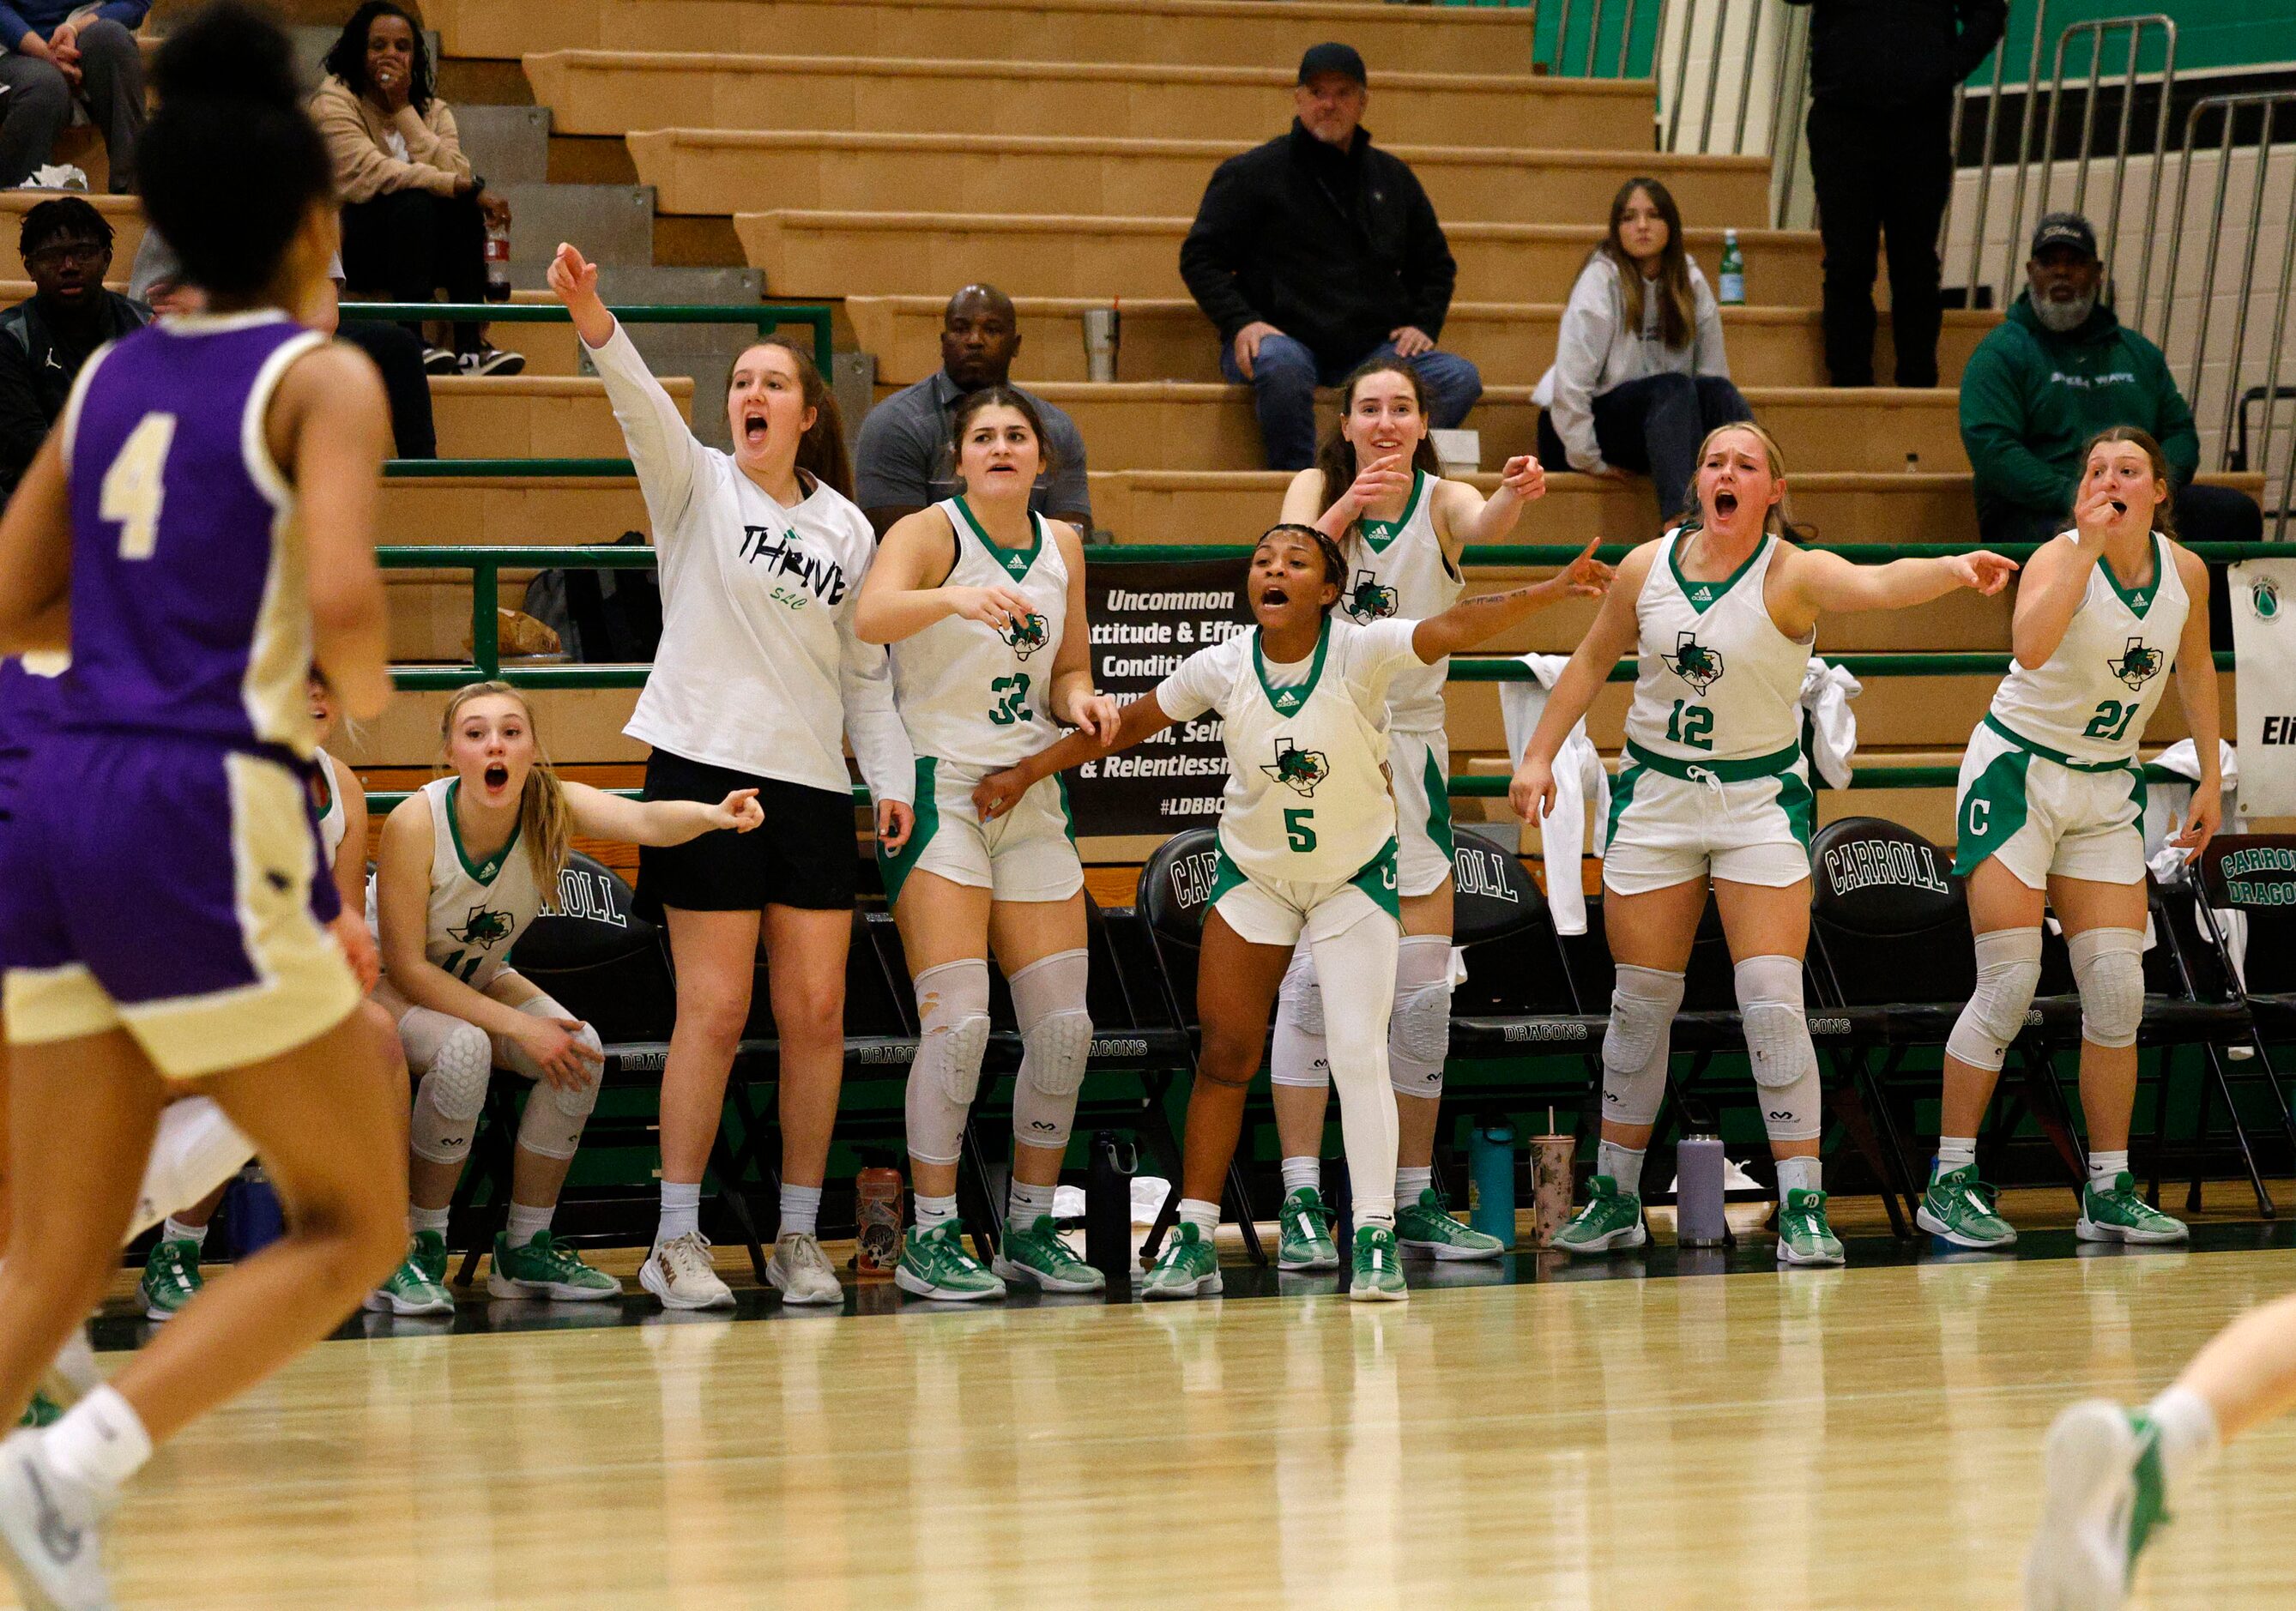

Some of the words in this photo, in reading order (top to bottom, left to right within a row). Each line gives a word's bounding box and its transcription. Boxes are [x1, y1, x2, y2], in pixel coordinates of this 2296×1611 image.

[98, 410, 178, 559] 4
[1368, 533, 1391, 541] adidas
[739, 525, 846, 606] THRIVE
[769, 587, 808, 610] SLC
[1107, 589, 1235, 612] Uncommon
[1176, 621, 1194, 643] &
[1103, 655, 1183, 678] Conditi
[988, 673, 1033, 725] 32
[1665, 698, 1714, 751] 12
[2082, 700, 2140, 741] 21
[1079, 759, 1097, 779] &
[1284, 808, 1317, 853] 5
[1969, 798, 1991, 836] C
[1454, 848, 1519, 903] OLL
[1825, 840, 1949, 896] CARROLL
[1504, 1024, 1587, 1041] DRAGONS
[861, 1046, 919, 1065] DRAGO
